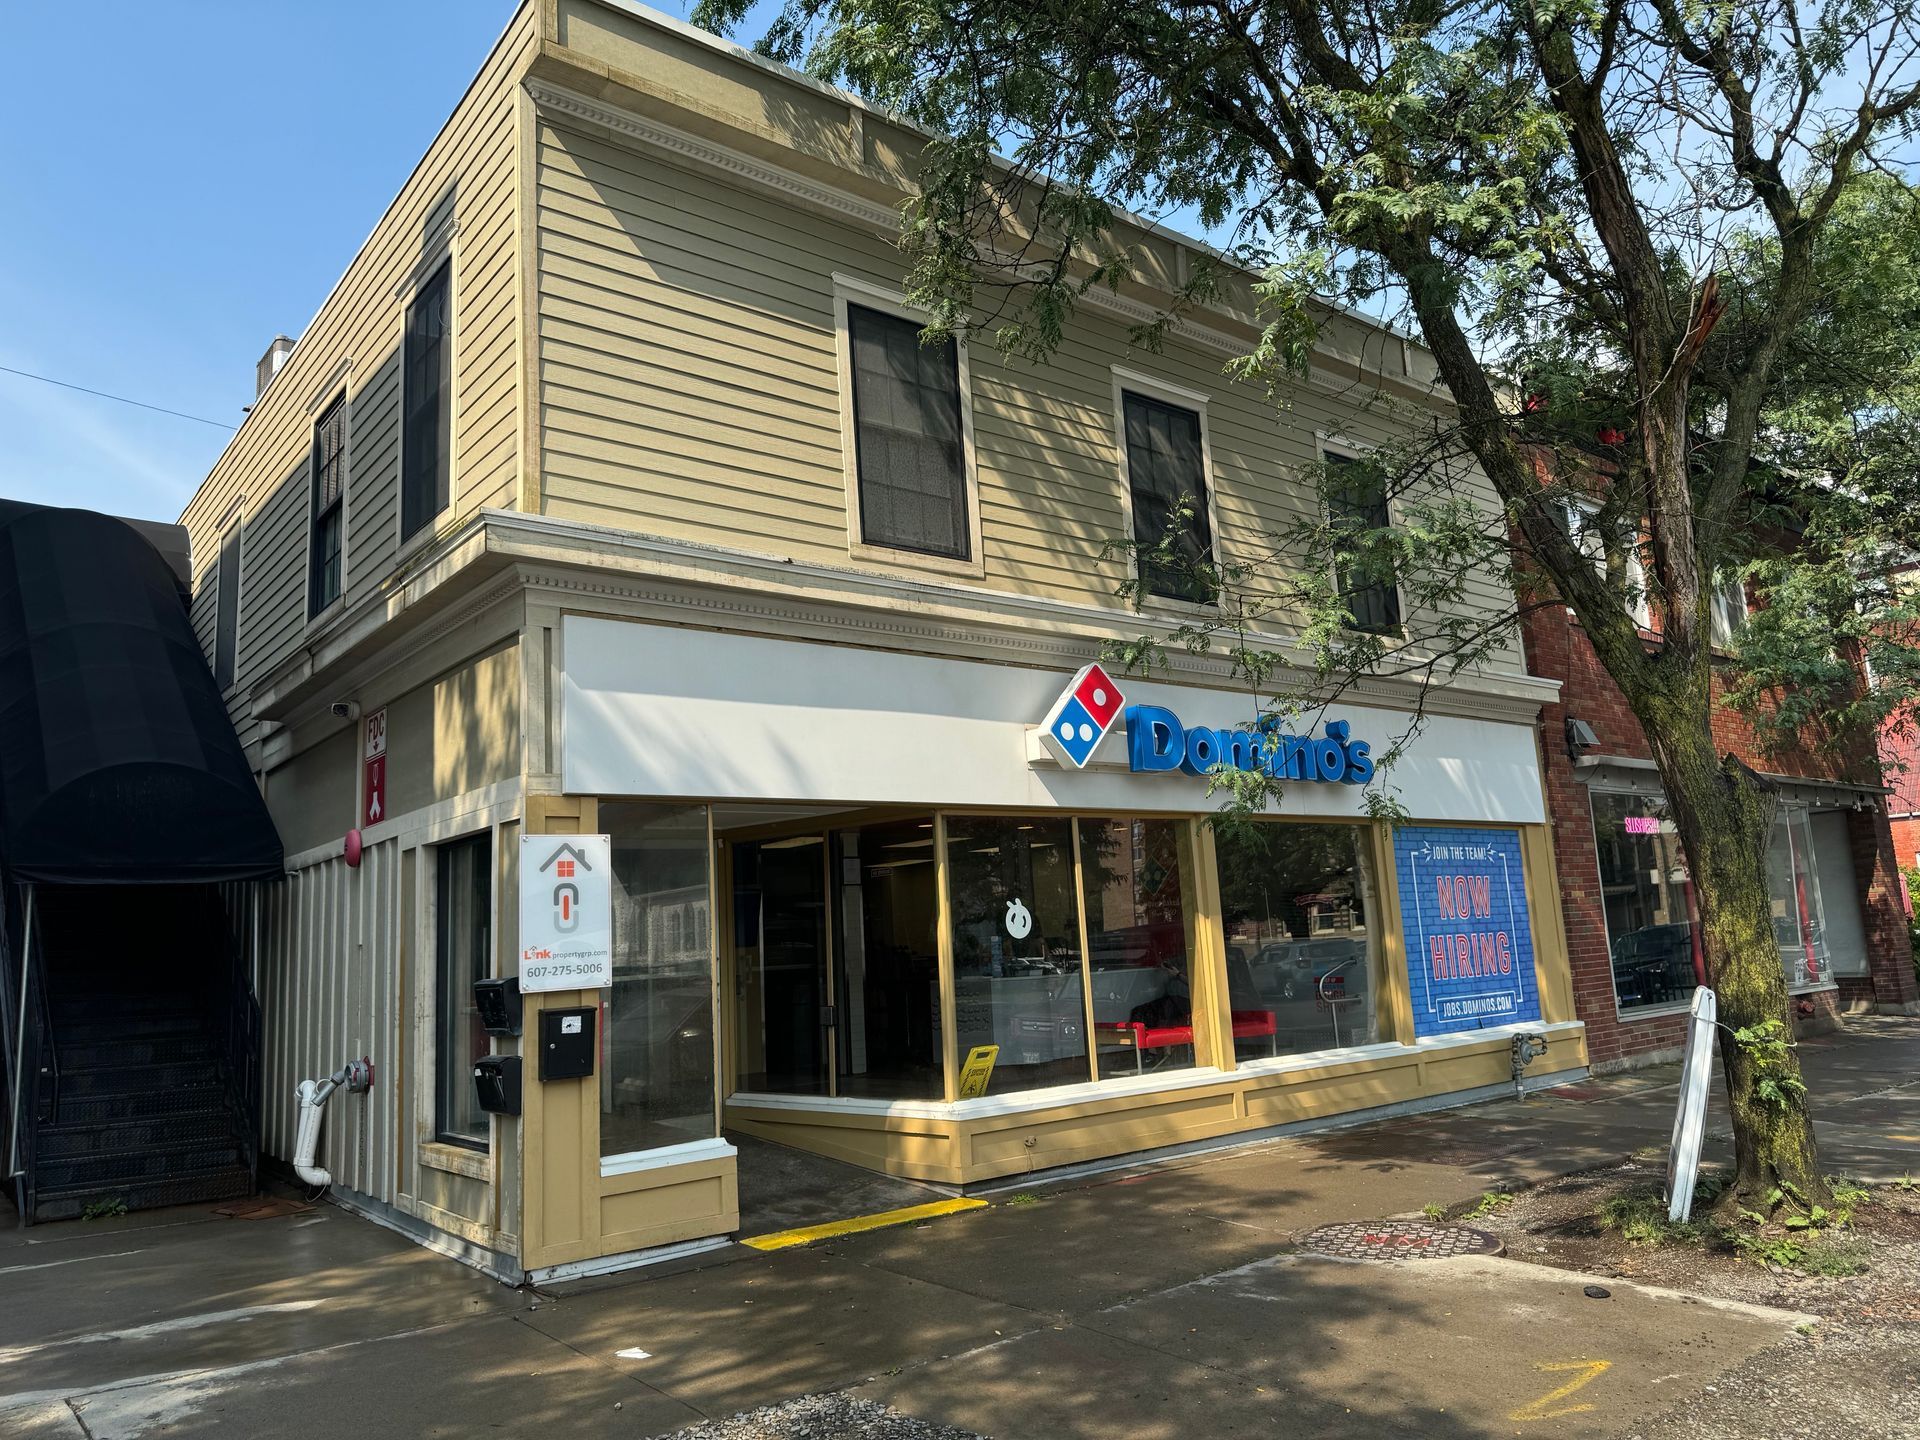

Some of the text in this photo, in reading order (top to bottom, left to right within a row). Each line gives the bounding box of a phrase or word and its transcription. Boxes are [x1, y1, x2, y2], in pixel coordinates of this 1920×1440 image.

[368, 711, 385, 743] FDC
[1125, 703, 1375, 785] Domino's
[1432, 846, 1487, 860] JOIN THE TEAM!
[1436, 875, 1491, 920] NOW
[552, 949, 608, 960] propertygrp.com
[1430, 931, 1512, 981] HIRING
[527, 963, 603, 978] 607-275-5006
[1443, 995, 1513, 1017] JOBS.DOMINOS.COM
